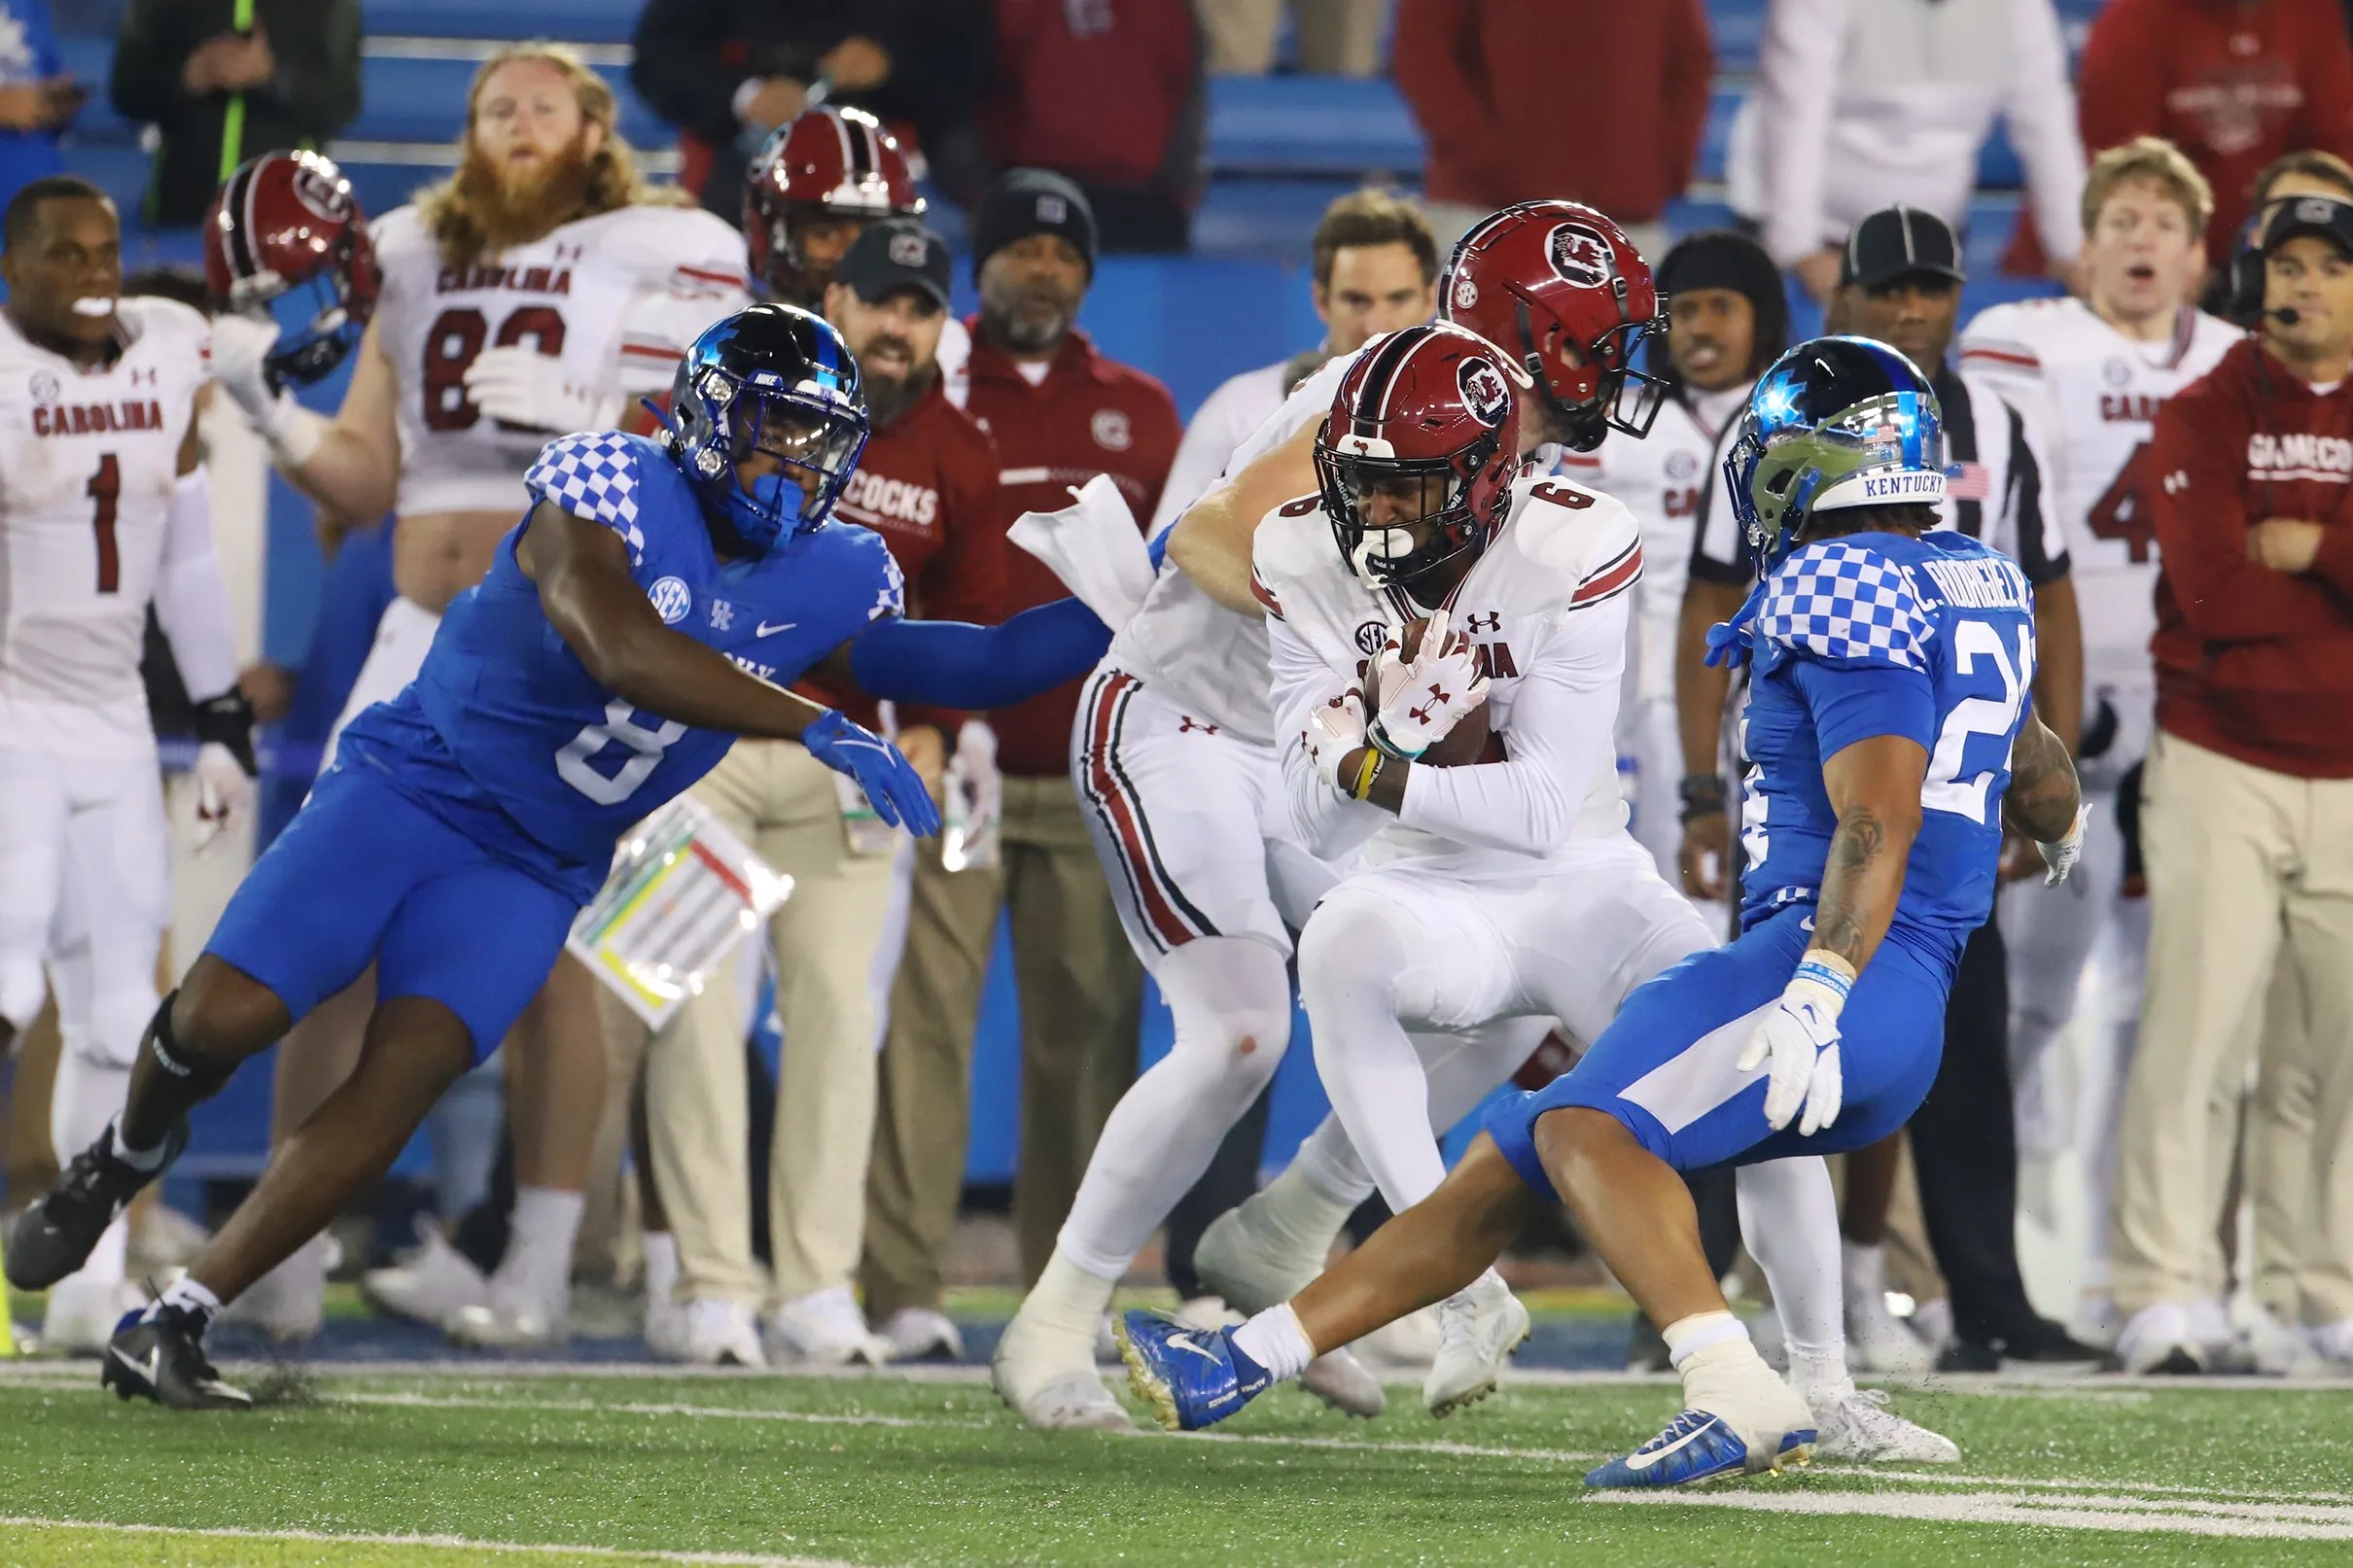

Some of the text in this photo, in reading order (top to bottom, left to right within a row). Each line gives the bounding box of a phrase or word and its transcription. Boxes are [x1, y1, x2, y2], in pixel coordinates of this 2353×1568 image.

[754, 372, 778, 387] NIKE
[32, 401, 162, 436] CAROLINA
[2248, 433, 2353, 472] GAMECO
[843, 468, 938, 525] COCKS
[1529, 482, 1596, 509] 6
[1865, 474, 1943, 497] KENTUCKY
[86, 452, 120, 593] 1
[1373, 558, 1395, 571] Riddll
[650, 580, 687, 620] SEC
